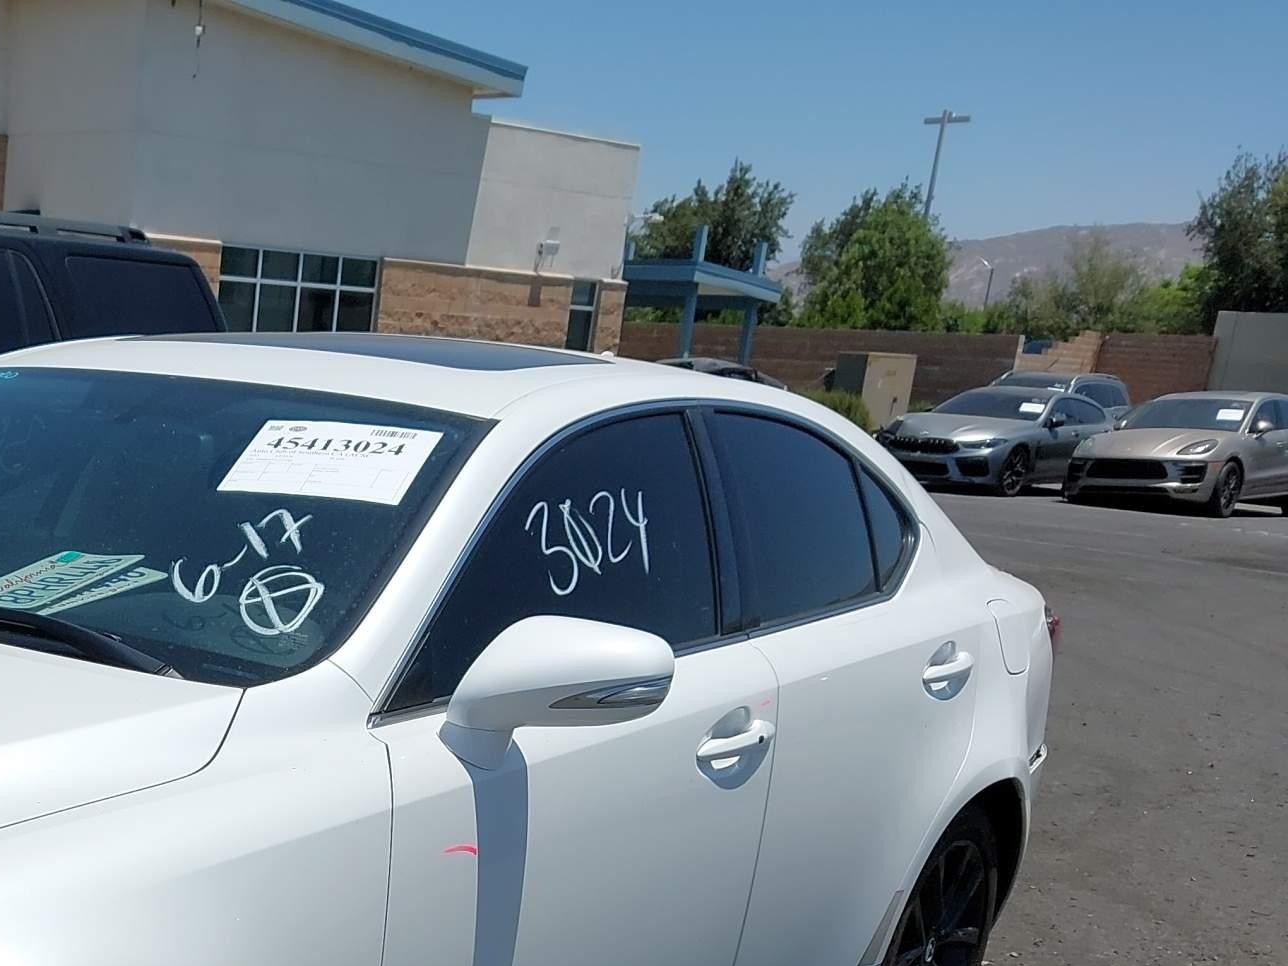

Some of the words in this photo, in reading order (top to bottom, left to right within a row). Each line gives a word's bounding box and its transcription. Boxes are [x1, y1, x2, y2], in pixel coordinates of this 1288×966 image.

[266, 436, 407, 456] 45413024
[170, 508, 313, 603] 6-17
[524, 487, 650, 596] 3024
